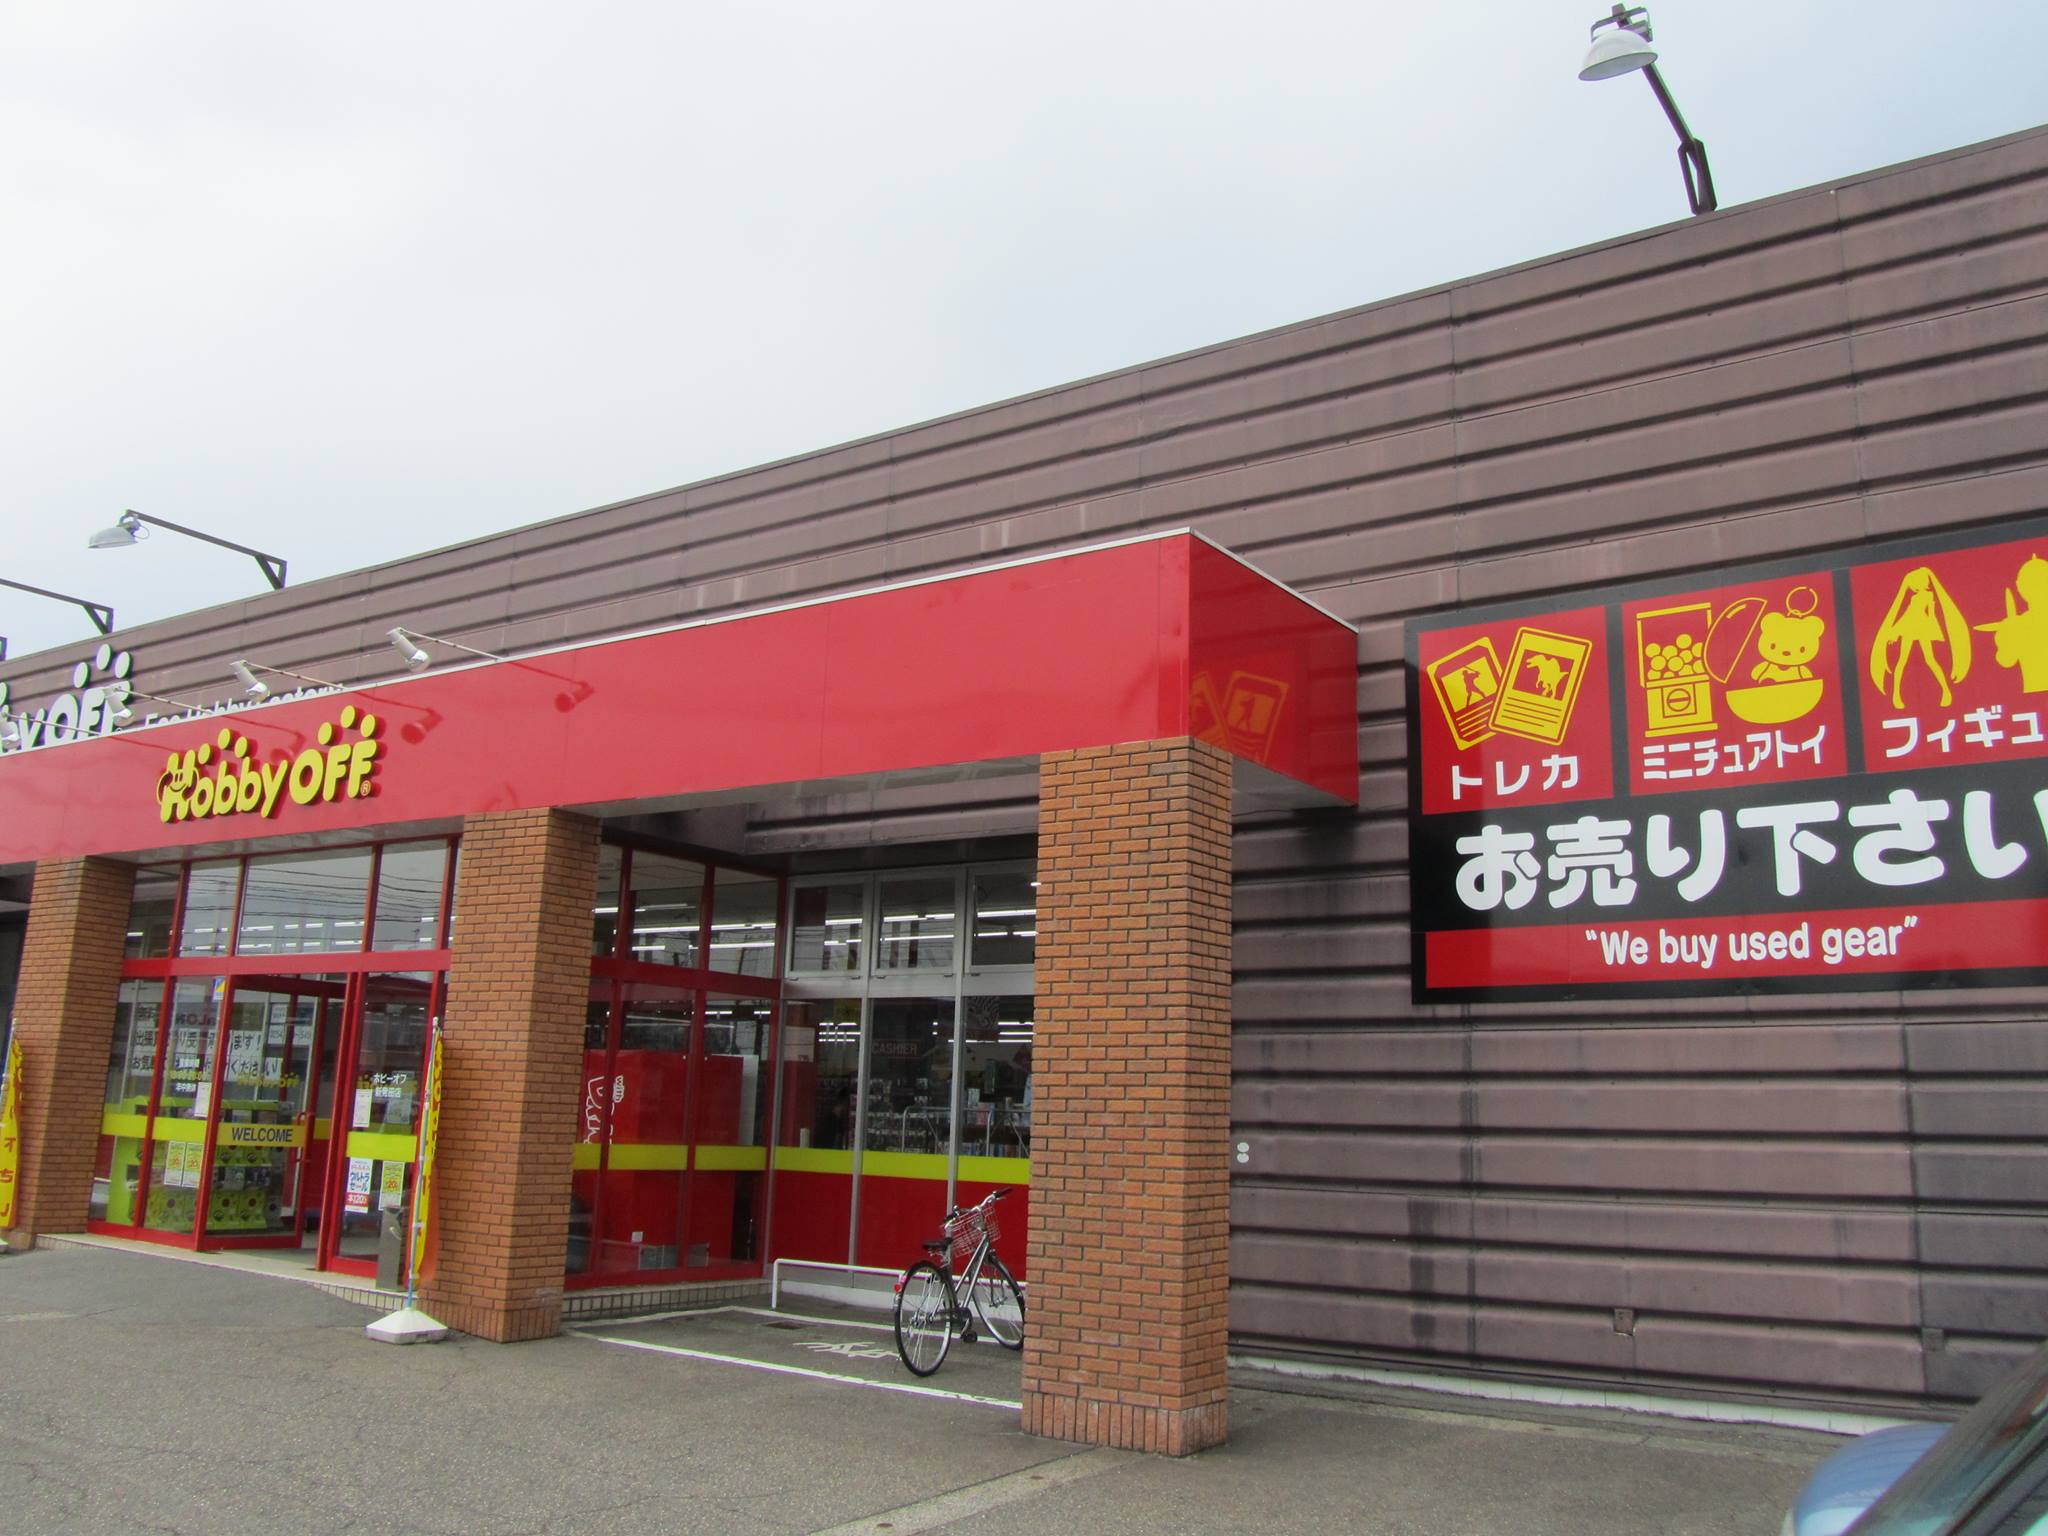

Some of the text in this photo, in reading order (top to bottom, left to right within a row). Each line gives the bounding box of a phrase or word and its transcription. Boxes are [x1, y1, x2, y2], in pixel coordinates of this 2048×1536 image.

[1642, 724, 1826, 782] ミニチュアトイ
[1451, 754, 1579, 801] トレカ
[1455, 788, 2048, 911] お売り下さい
[1659, 925, 1719, 968] buy
[1728, 922, 1810, 963] used
[373, 1072, 407, 1084] ホビーオフ
[231, 1127, 293, 1143] WELCOME
